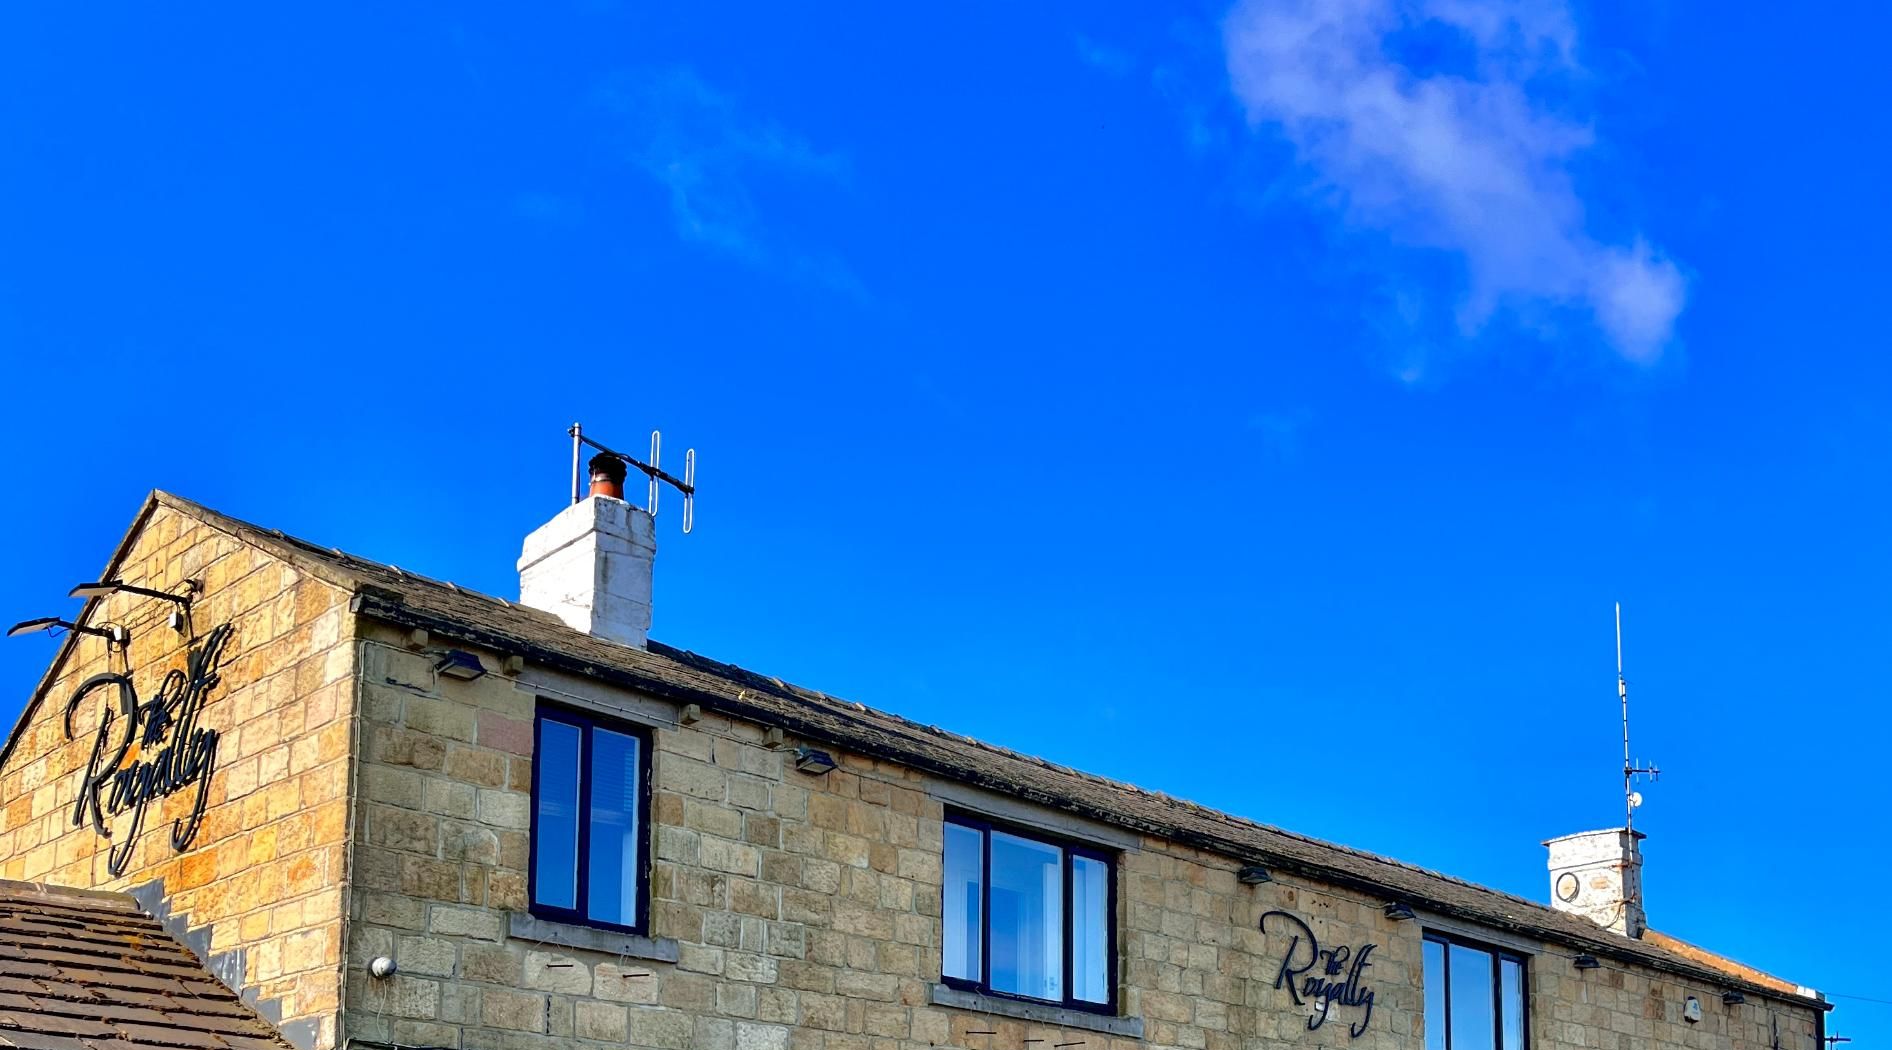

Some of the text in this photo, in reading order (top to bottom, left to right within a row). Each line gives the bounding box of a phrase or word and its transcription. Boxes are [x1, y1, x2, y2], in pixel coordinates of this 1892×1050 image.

[64, 621, 232, 876] Royalty
[1260, 910, 1378, 1038] Royalty
[1319, 945, 1350, 975] The
